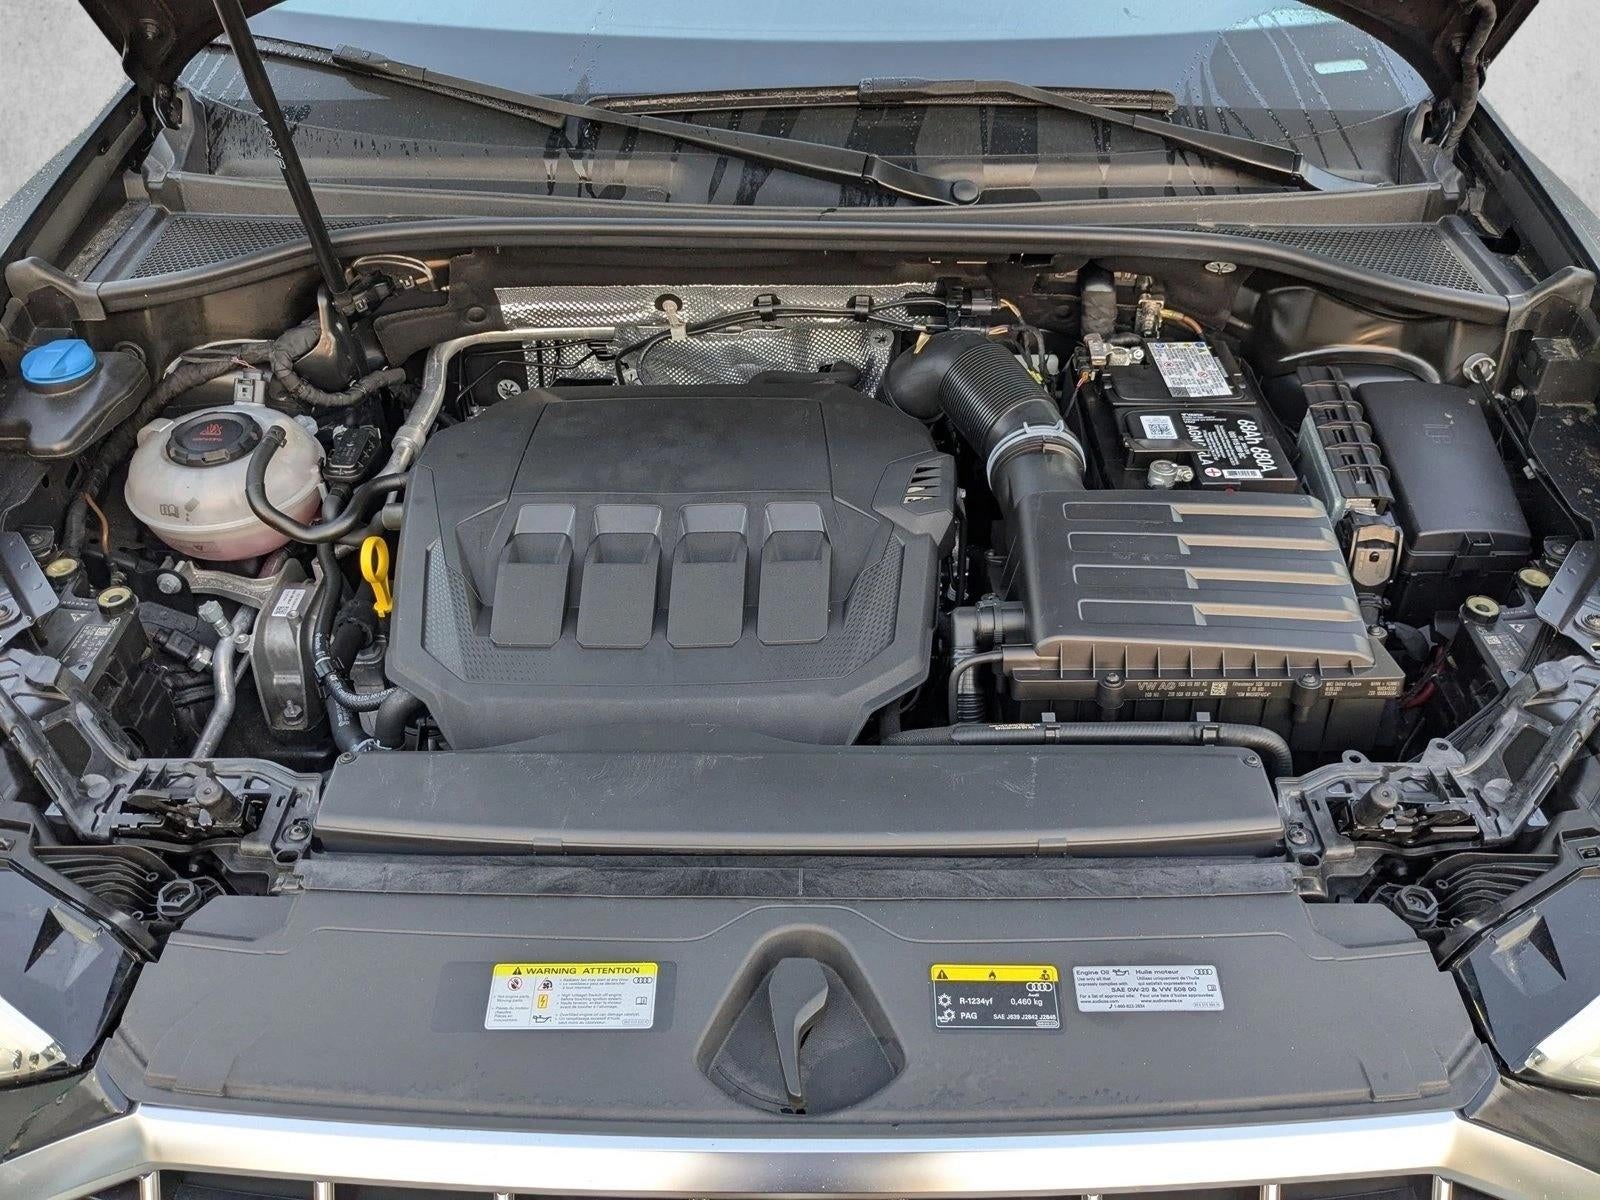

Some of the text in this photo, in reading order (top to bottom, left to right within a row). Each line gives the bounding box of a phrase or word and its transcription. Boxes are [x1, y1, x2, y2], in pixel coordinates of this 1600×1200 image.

[1186, 424, 1204, 442] AGM
[1237, 419, 1264, 444] 68Ah
[1250, 446, 1278, 472] 680A
[1138, 682, 1157, 690] VW
[960, 998, 992, 1006] R-1234yf
[1033, 998, 1043, 1006] kg
